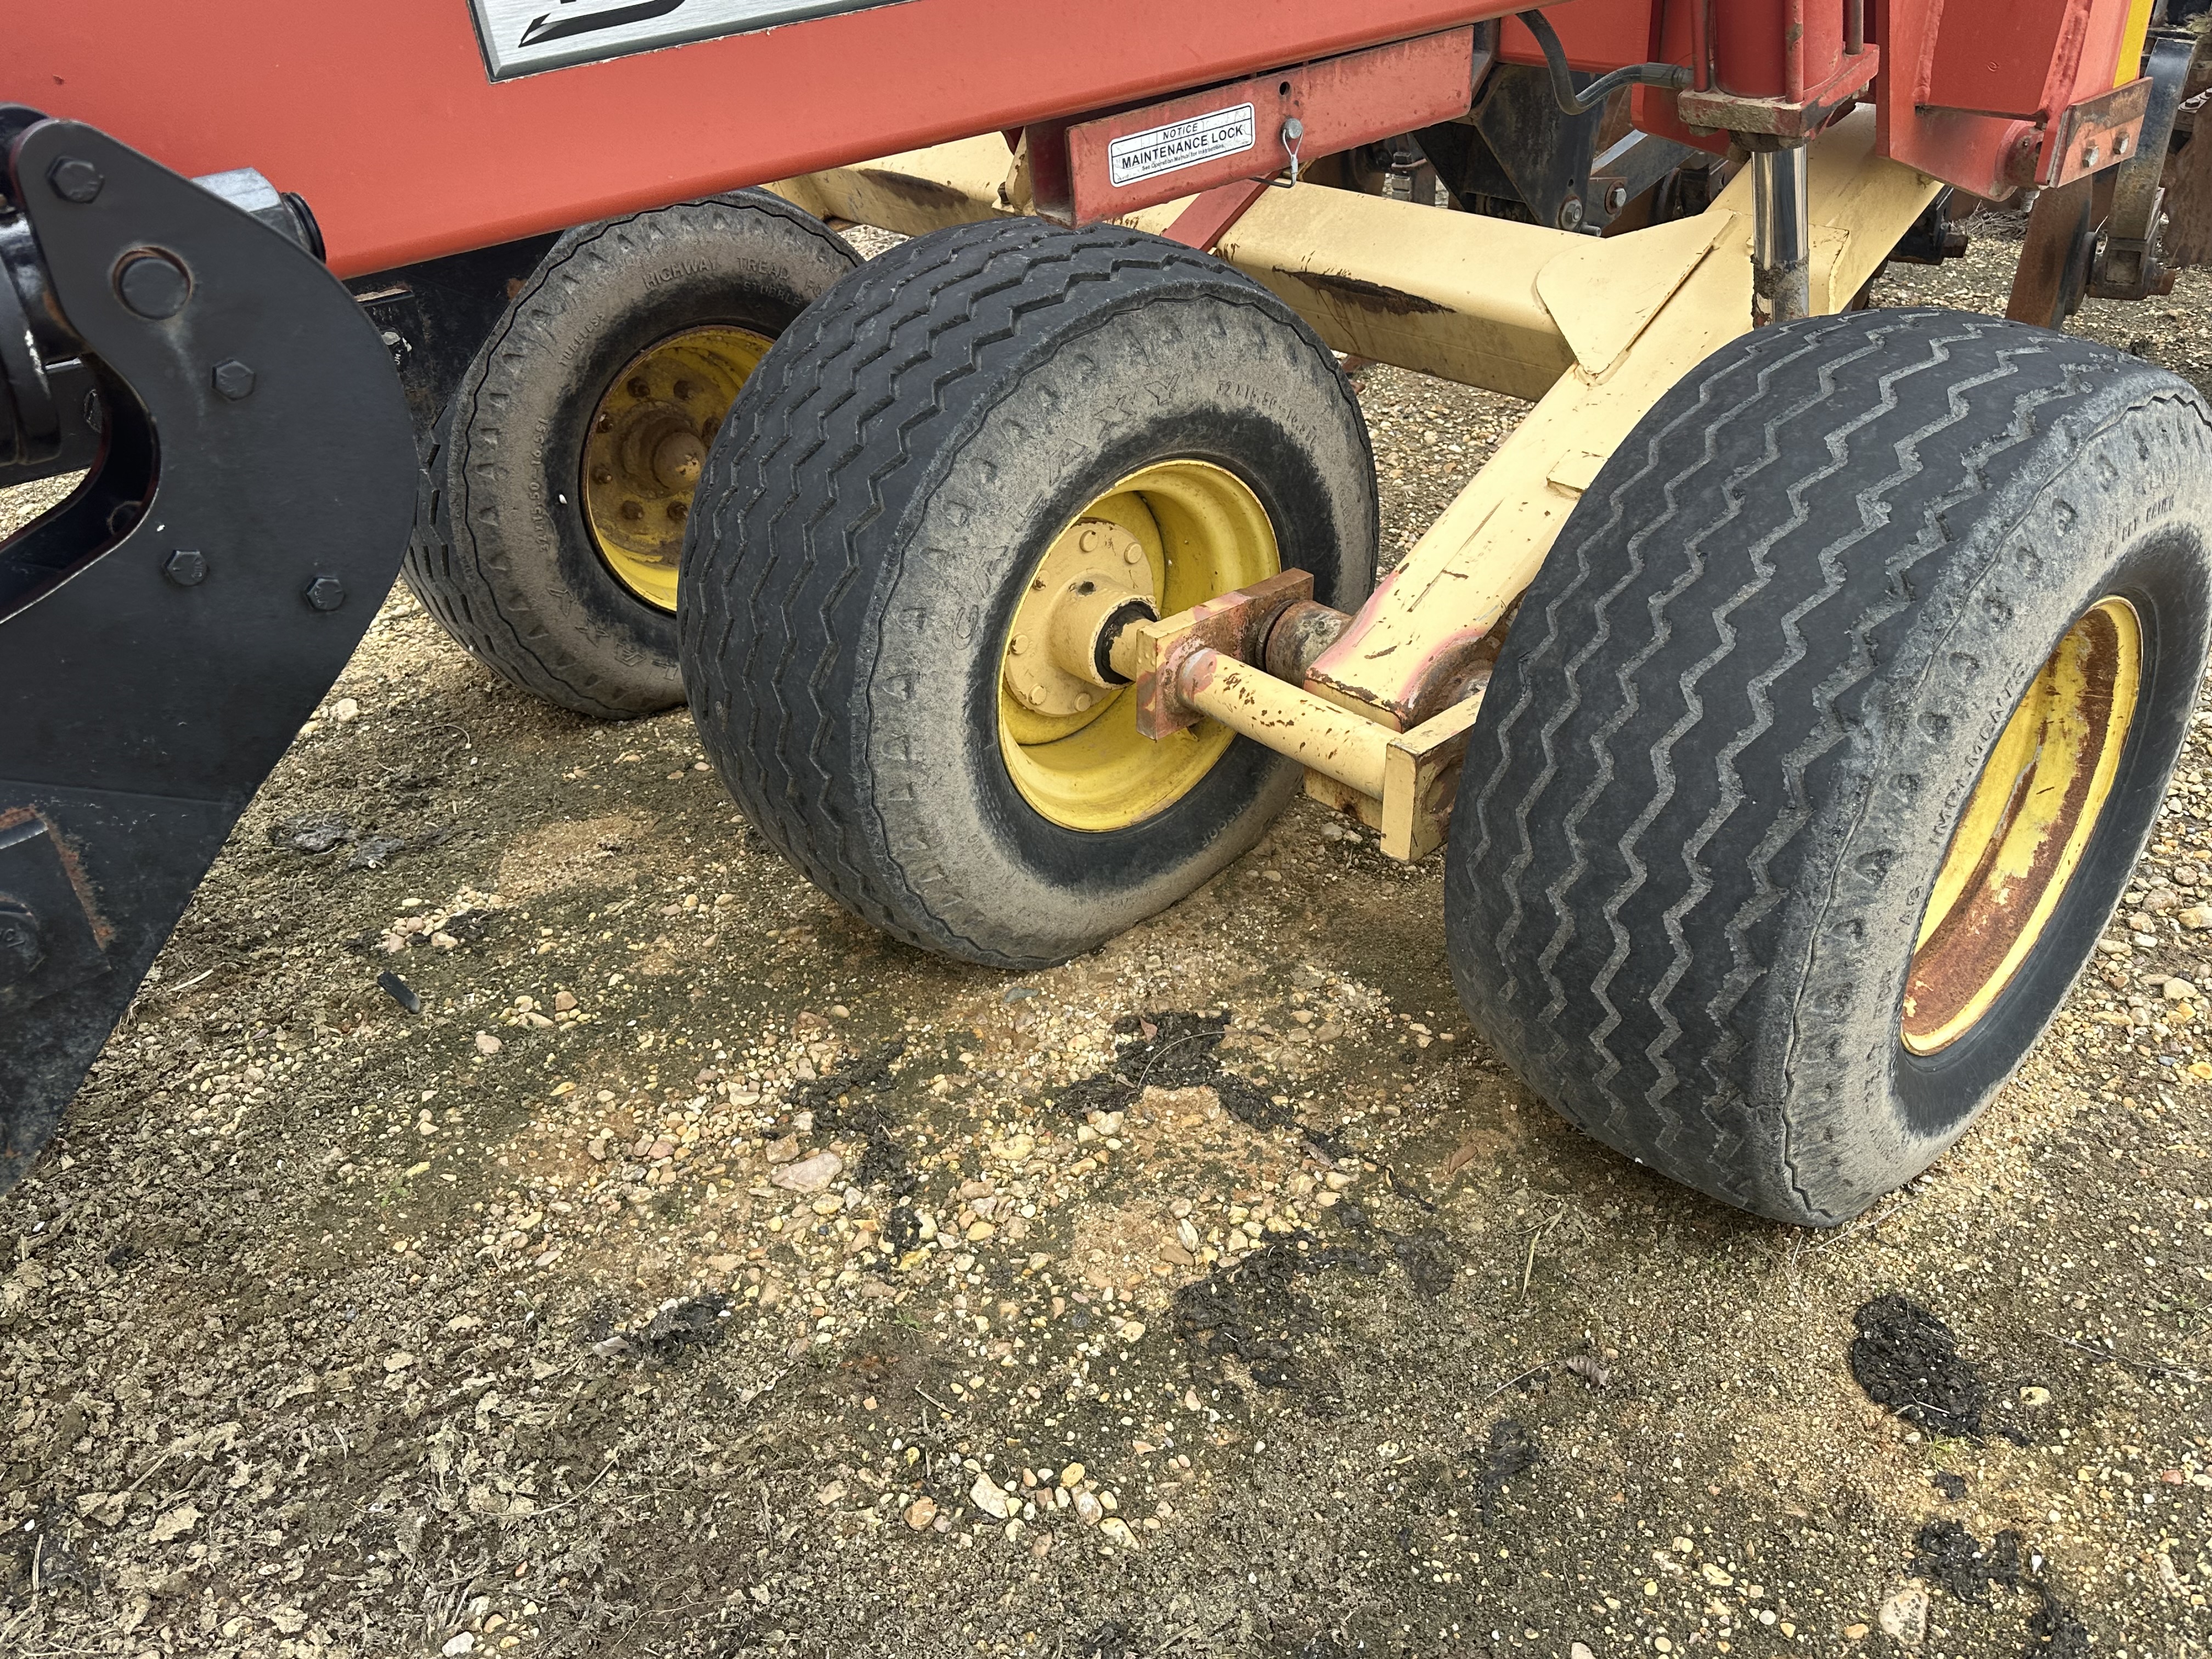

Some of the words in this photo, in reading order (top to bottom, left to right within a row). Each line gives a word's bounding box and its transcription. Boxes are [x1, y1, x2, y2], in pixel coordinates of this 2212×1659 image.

[1122, 135, 1208, 169] MAINTENANCE
[1211, 125, 1243, 143] LOCK
[1163, 123, 1198, 140] NOTICE
[641, 256, 719, 290] HIGHWAY
[737, 256, 789, 280] TREAD
[804, 279, 822, 298] FO
[743, 281, 803, 308] STUBBLE
[557, 311, 605, 367] TUBELESS
[548, 586, 679, 681] LAXY
